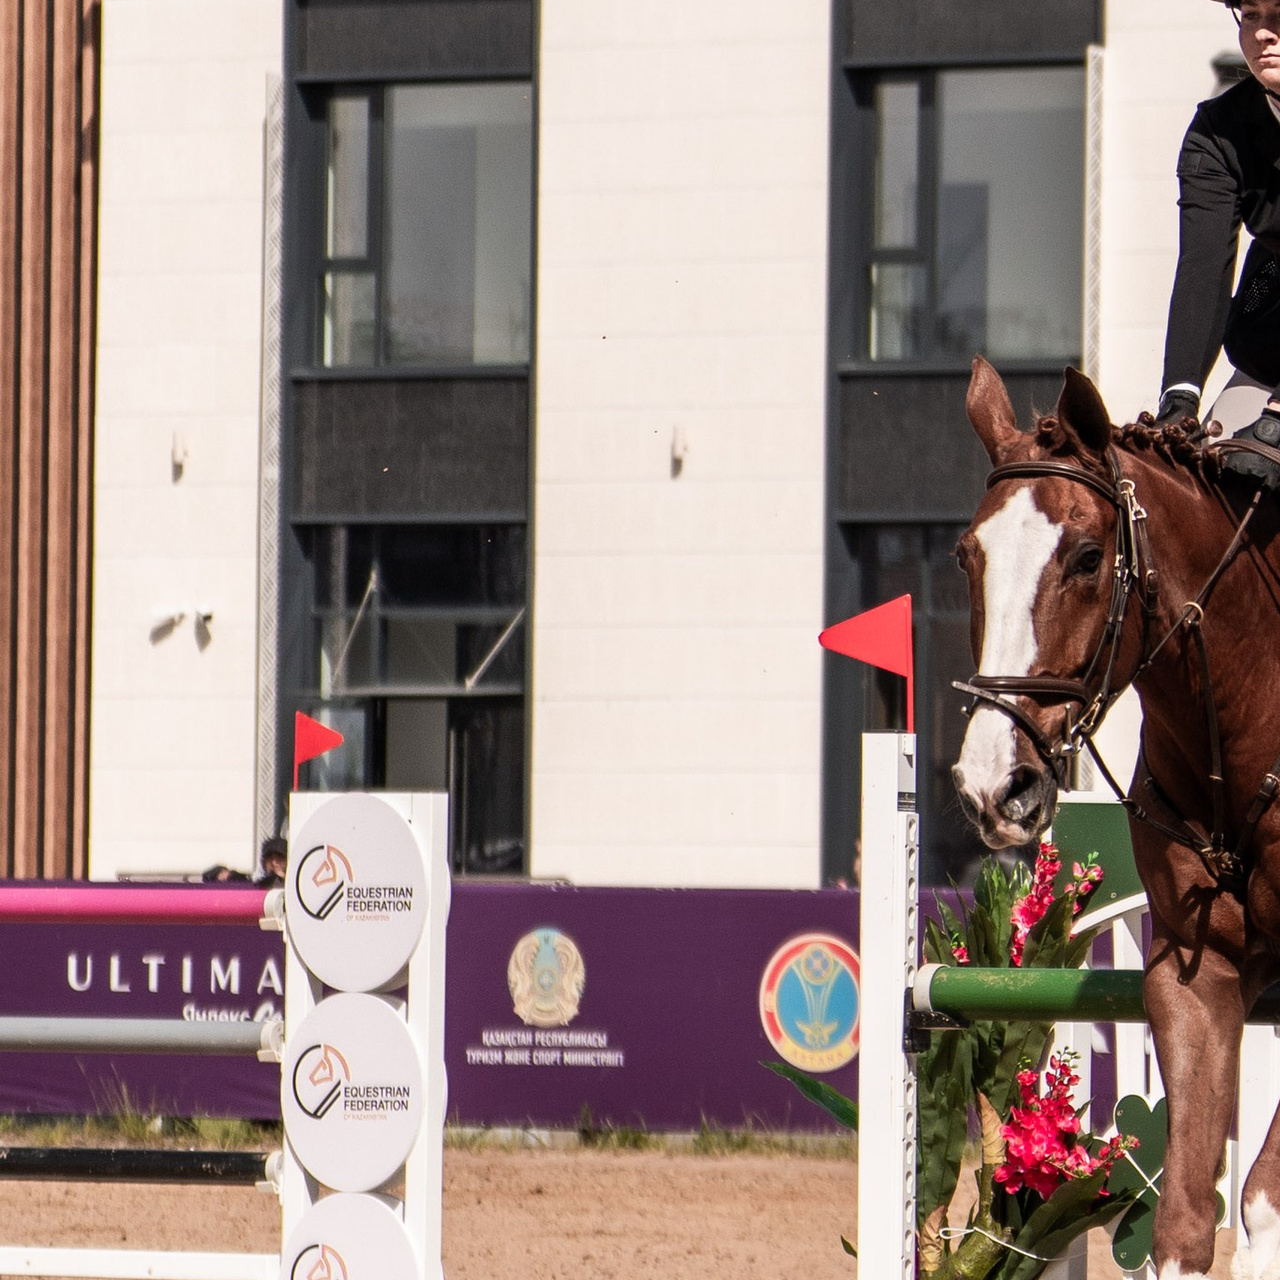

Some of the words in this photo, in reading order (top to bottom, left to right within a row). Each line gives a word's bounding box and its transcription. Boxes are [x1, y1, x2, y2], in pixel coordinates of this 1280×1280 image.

[346, 887, 413, 899] EQUESTRIAN
[346, 900, 412, 912] FEDERATION
[67, 953, 284, 995] ULTIMA
[466, 1048, 503, 1066] ТУРИЗМ
[533, 1050, 562, 1066] СПОРТ
[343, 1086, 410, 1098] EQUESTRIAN
[343, 1100, 409, 1111] FEDERATION
